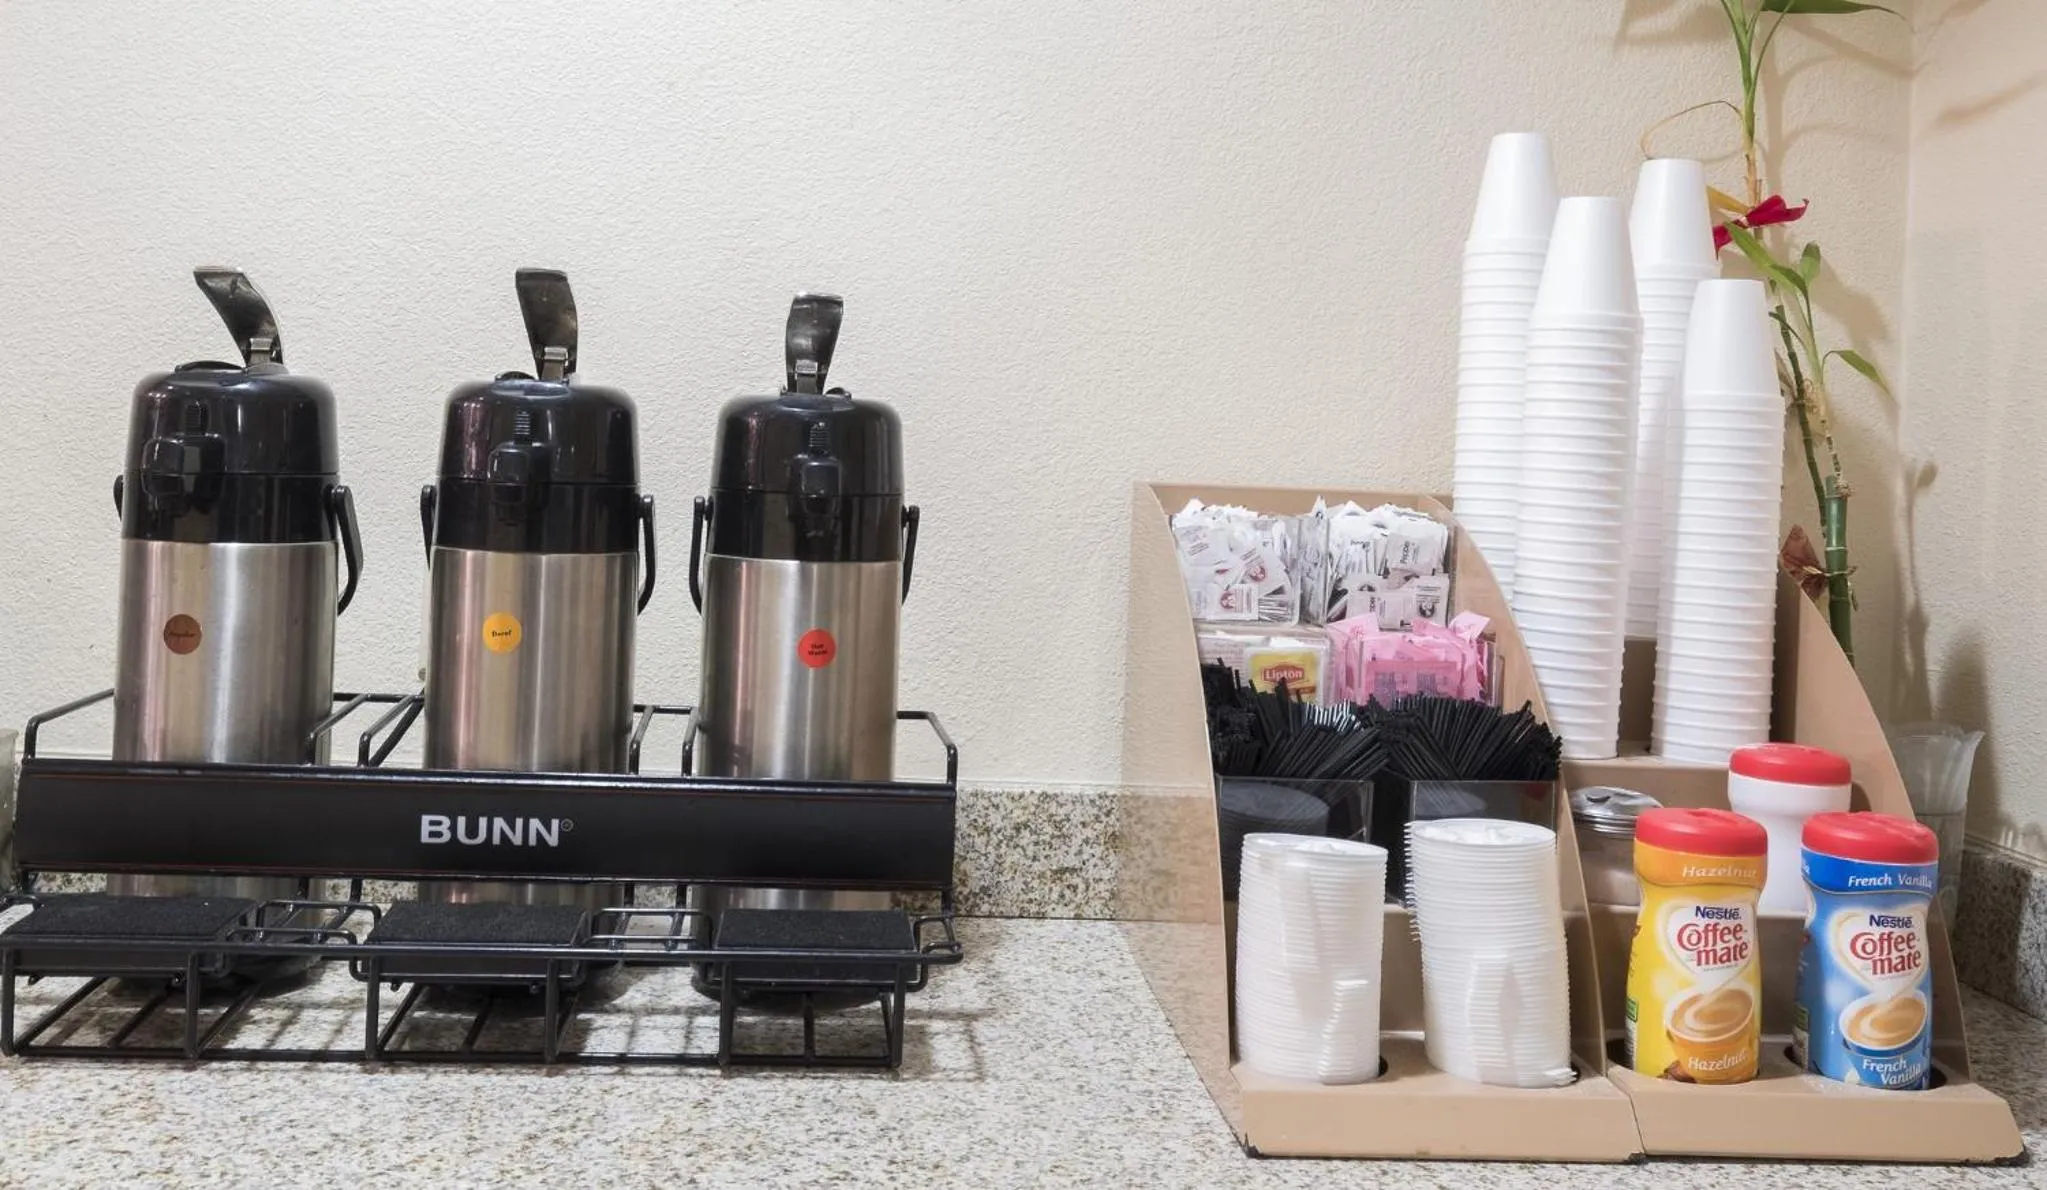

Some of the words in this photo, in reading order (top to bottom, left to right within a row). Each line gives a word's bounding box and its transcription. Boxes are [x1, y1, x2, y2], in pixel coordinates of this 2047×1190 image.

[1265, 667, 1304, 682] Lipton
[420, 813, 560, 848] BUNN
[1682, 863, 1757, 880] Hazelnut
[1848, 873, 1892, 888] French
[1898, 873, 1933, 888] Vanilla
[1695, 905, 1741, 920] Nestlé
[1869, 914, 1913, 929] Nestlé
[1697, 941, 1749, 967] mate
[1872, 950, 1922, 976] mate
[1687, 1047, 1748, 1072] Hazelnut
[1862, 1055, 1907, 1073] French
[1880, 1063, 1923, 1086] Vanilla
